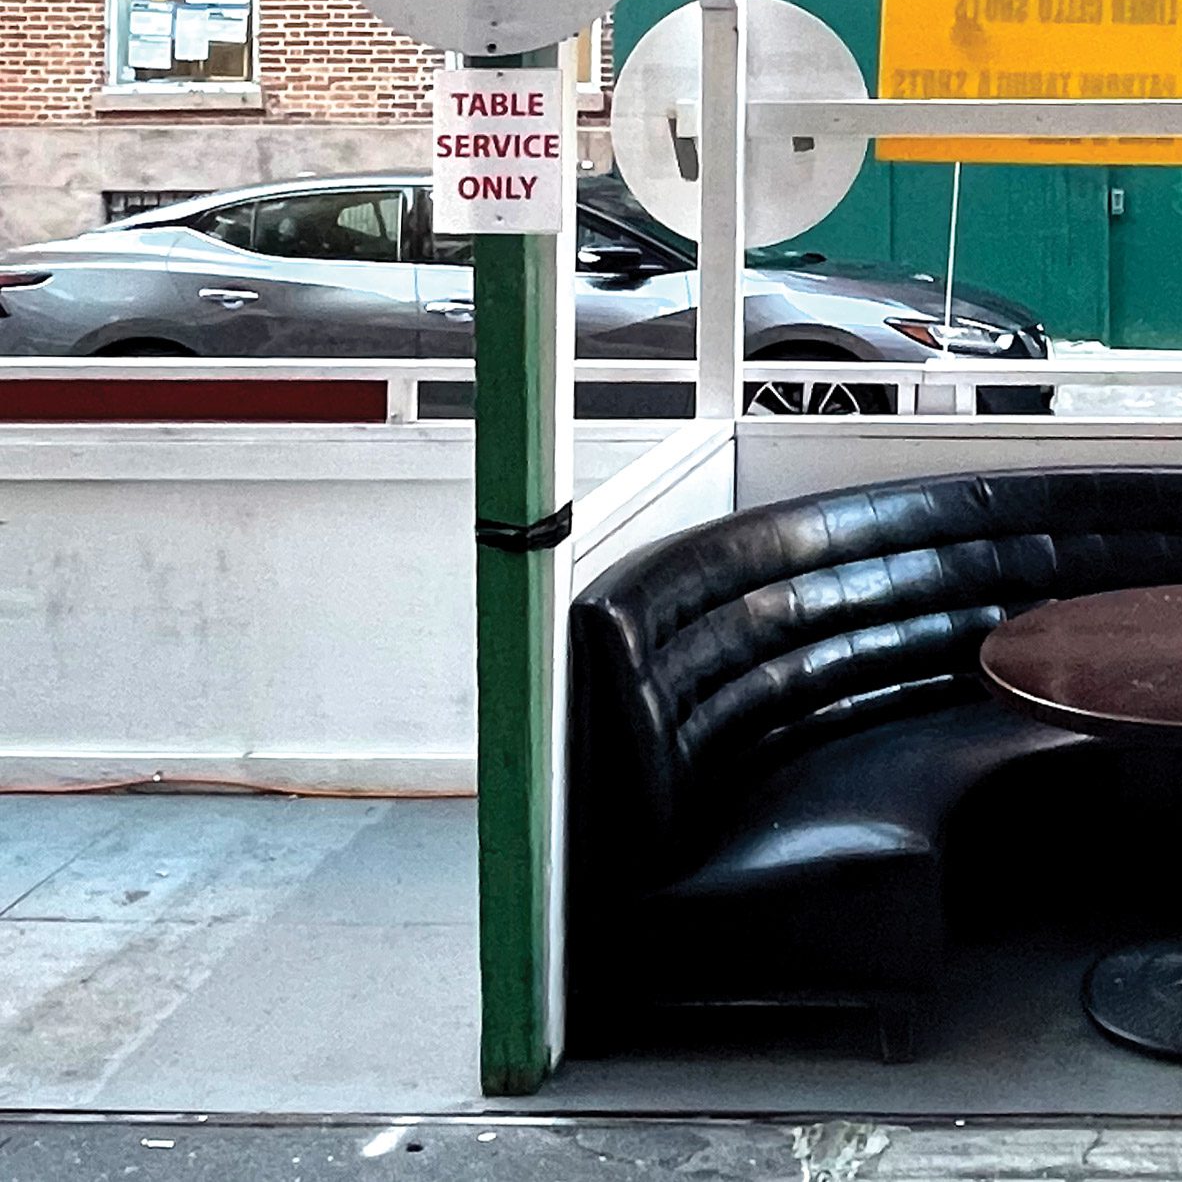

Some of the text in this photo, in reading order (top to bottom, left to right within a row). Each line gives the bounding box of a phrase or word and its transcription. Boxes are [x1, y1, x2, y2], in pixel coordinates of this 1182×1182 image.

[451, 92, 545, 118] TABLE
[436, 133, 560, 160] SERVICE
[458, 176, 538, 201] ONLY
